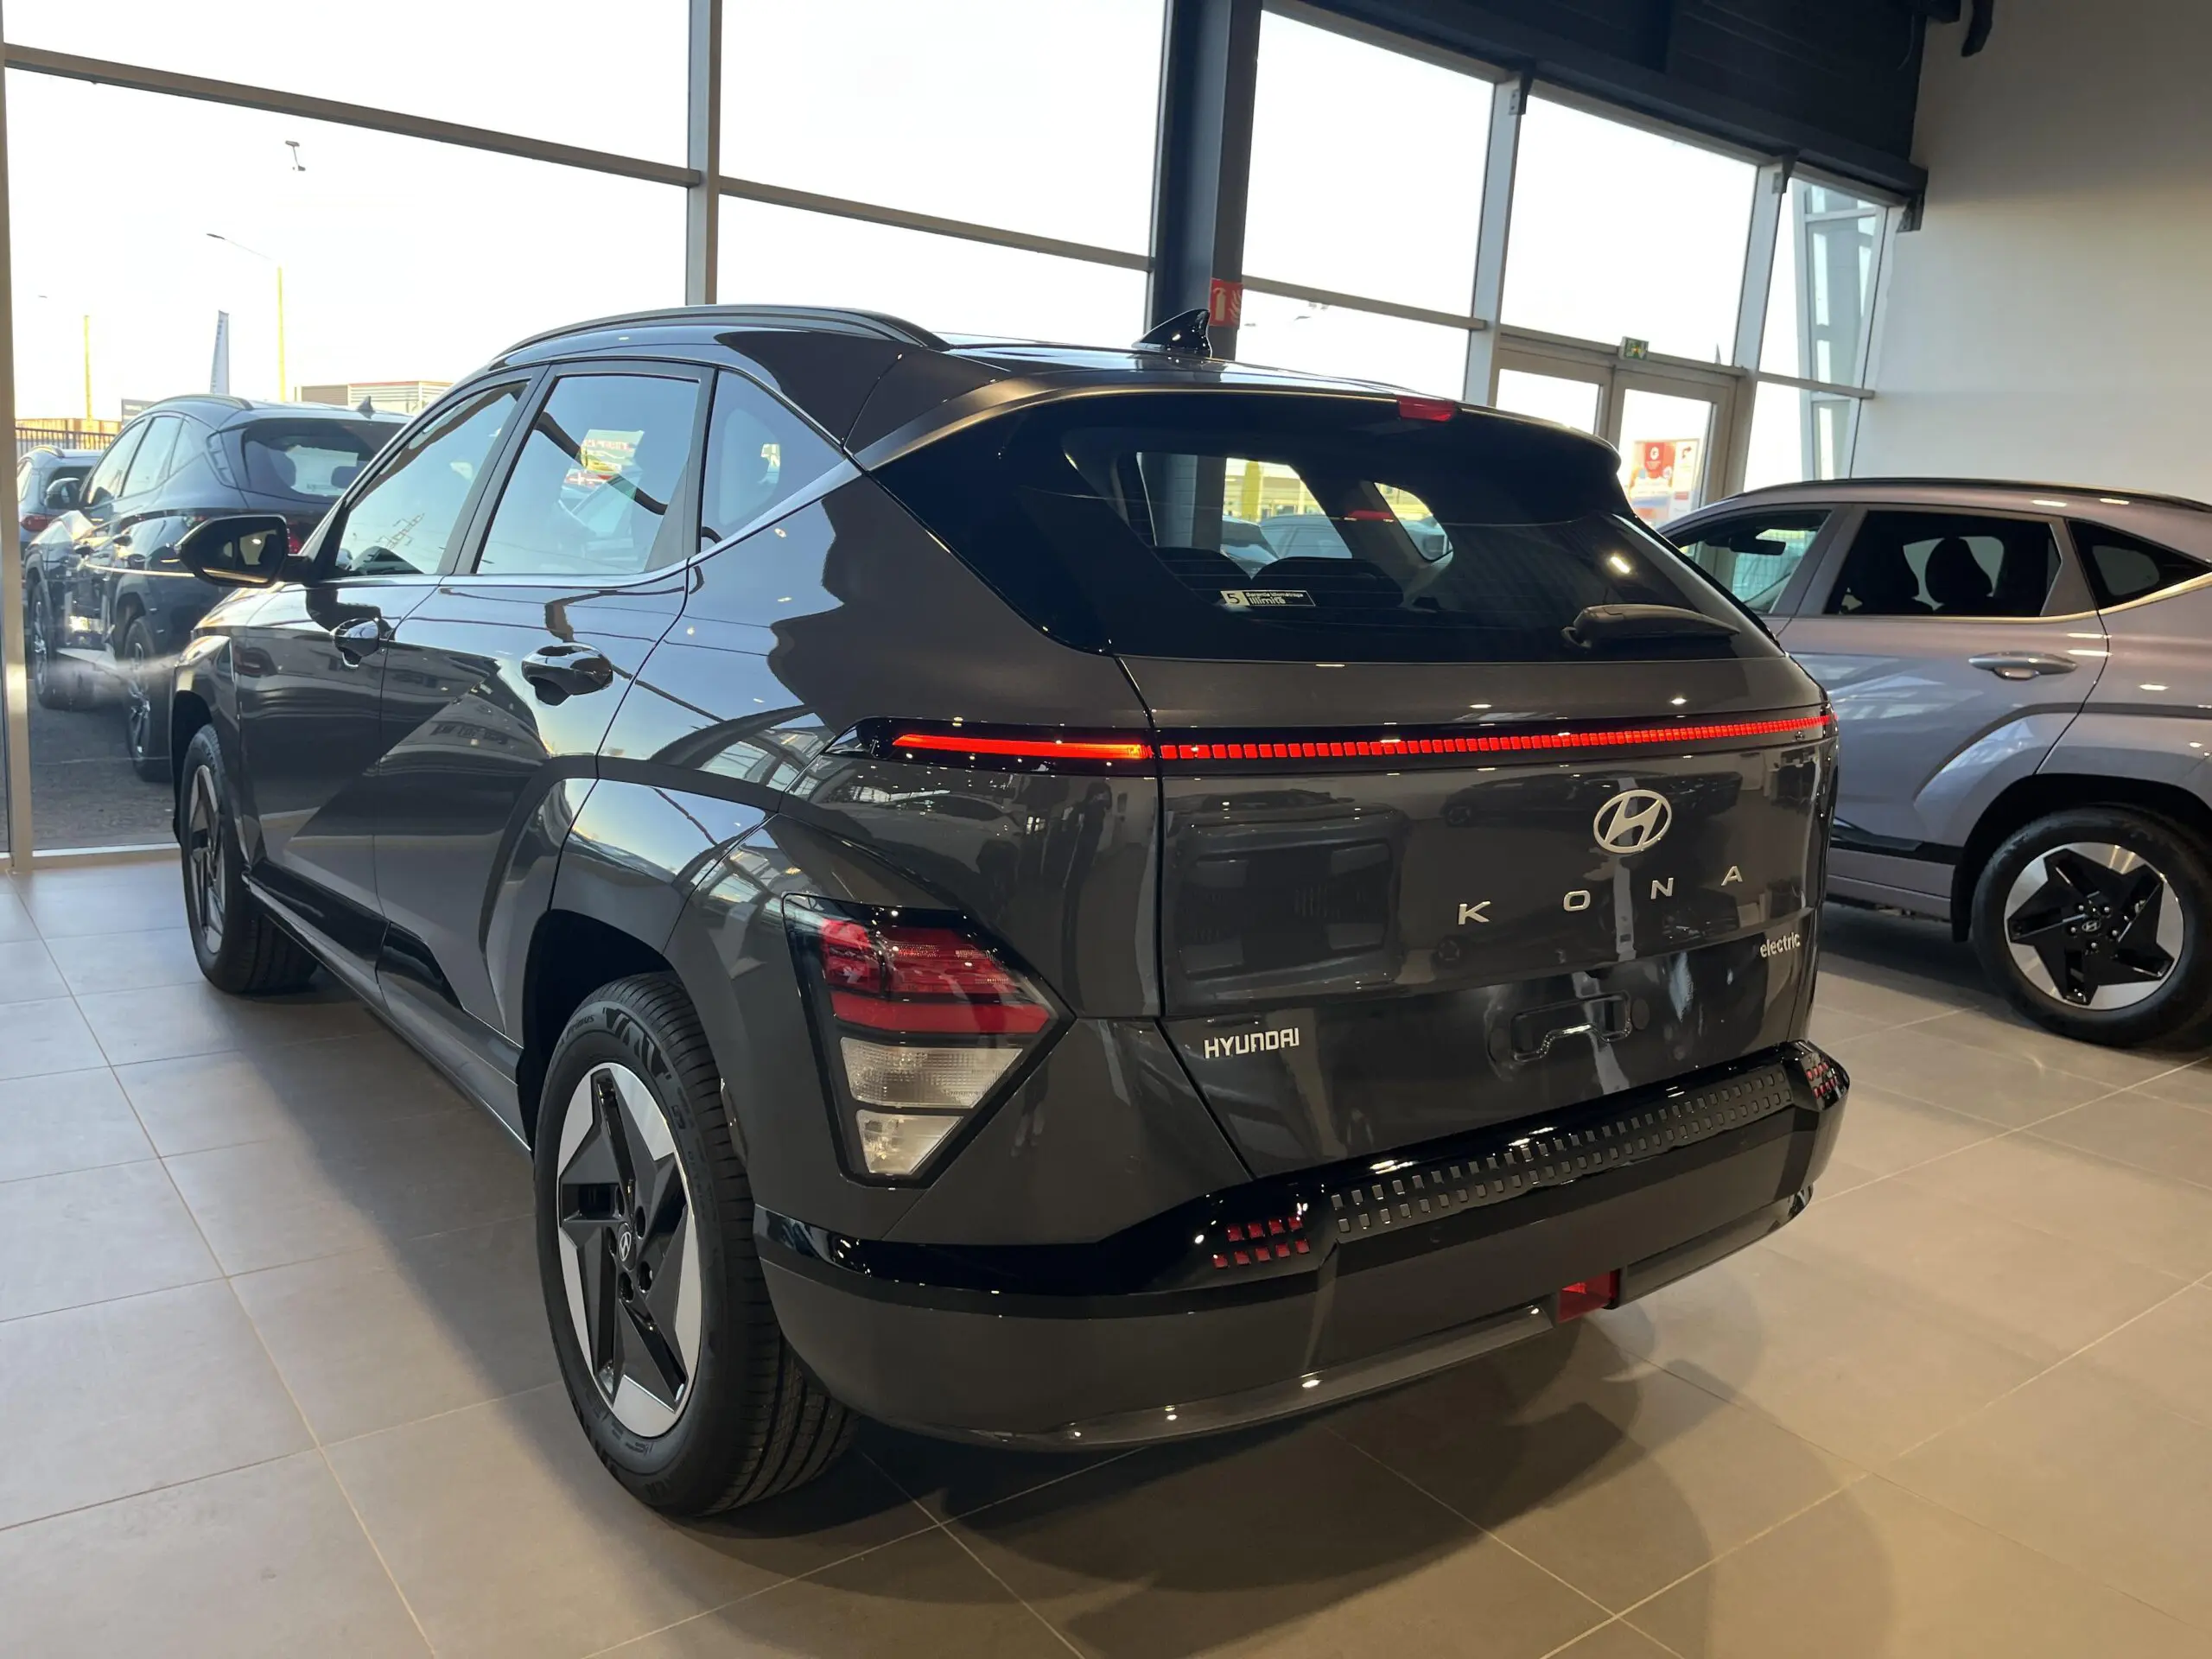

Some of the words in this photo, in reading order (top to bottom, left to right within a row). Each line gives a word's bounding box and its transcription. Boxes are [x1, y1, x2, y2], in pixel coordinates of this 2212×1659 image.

[1226, 593, 1241, 604] 5
[1759, 931, 1801, 958] electric
[1204, 1027, 1300, 1059] HYUNDAI
